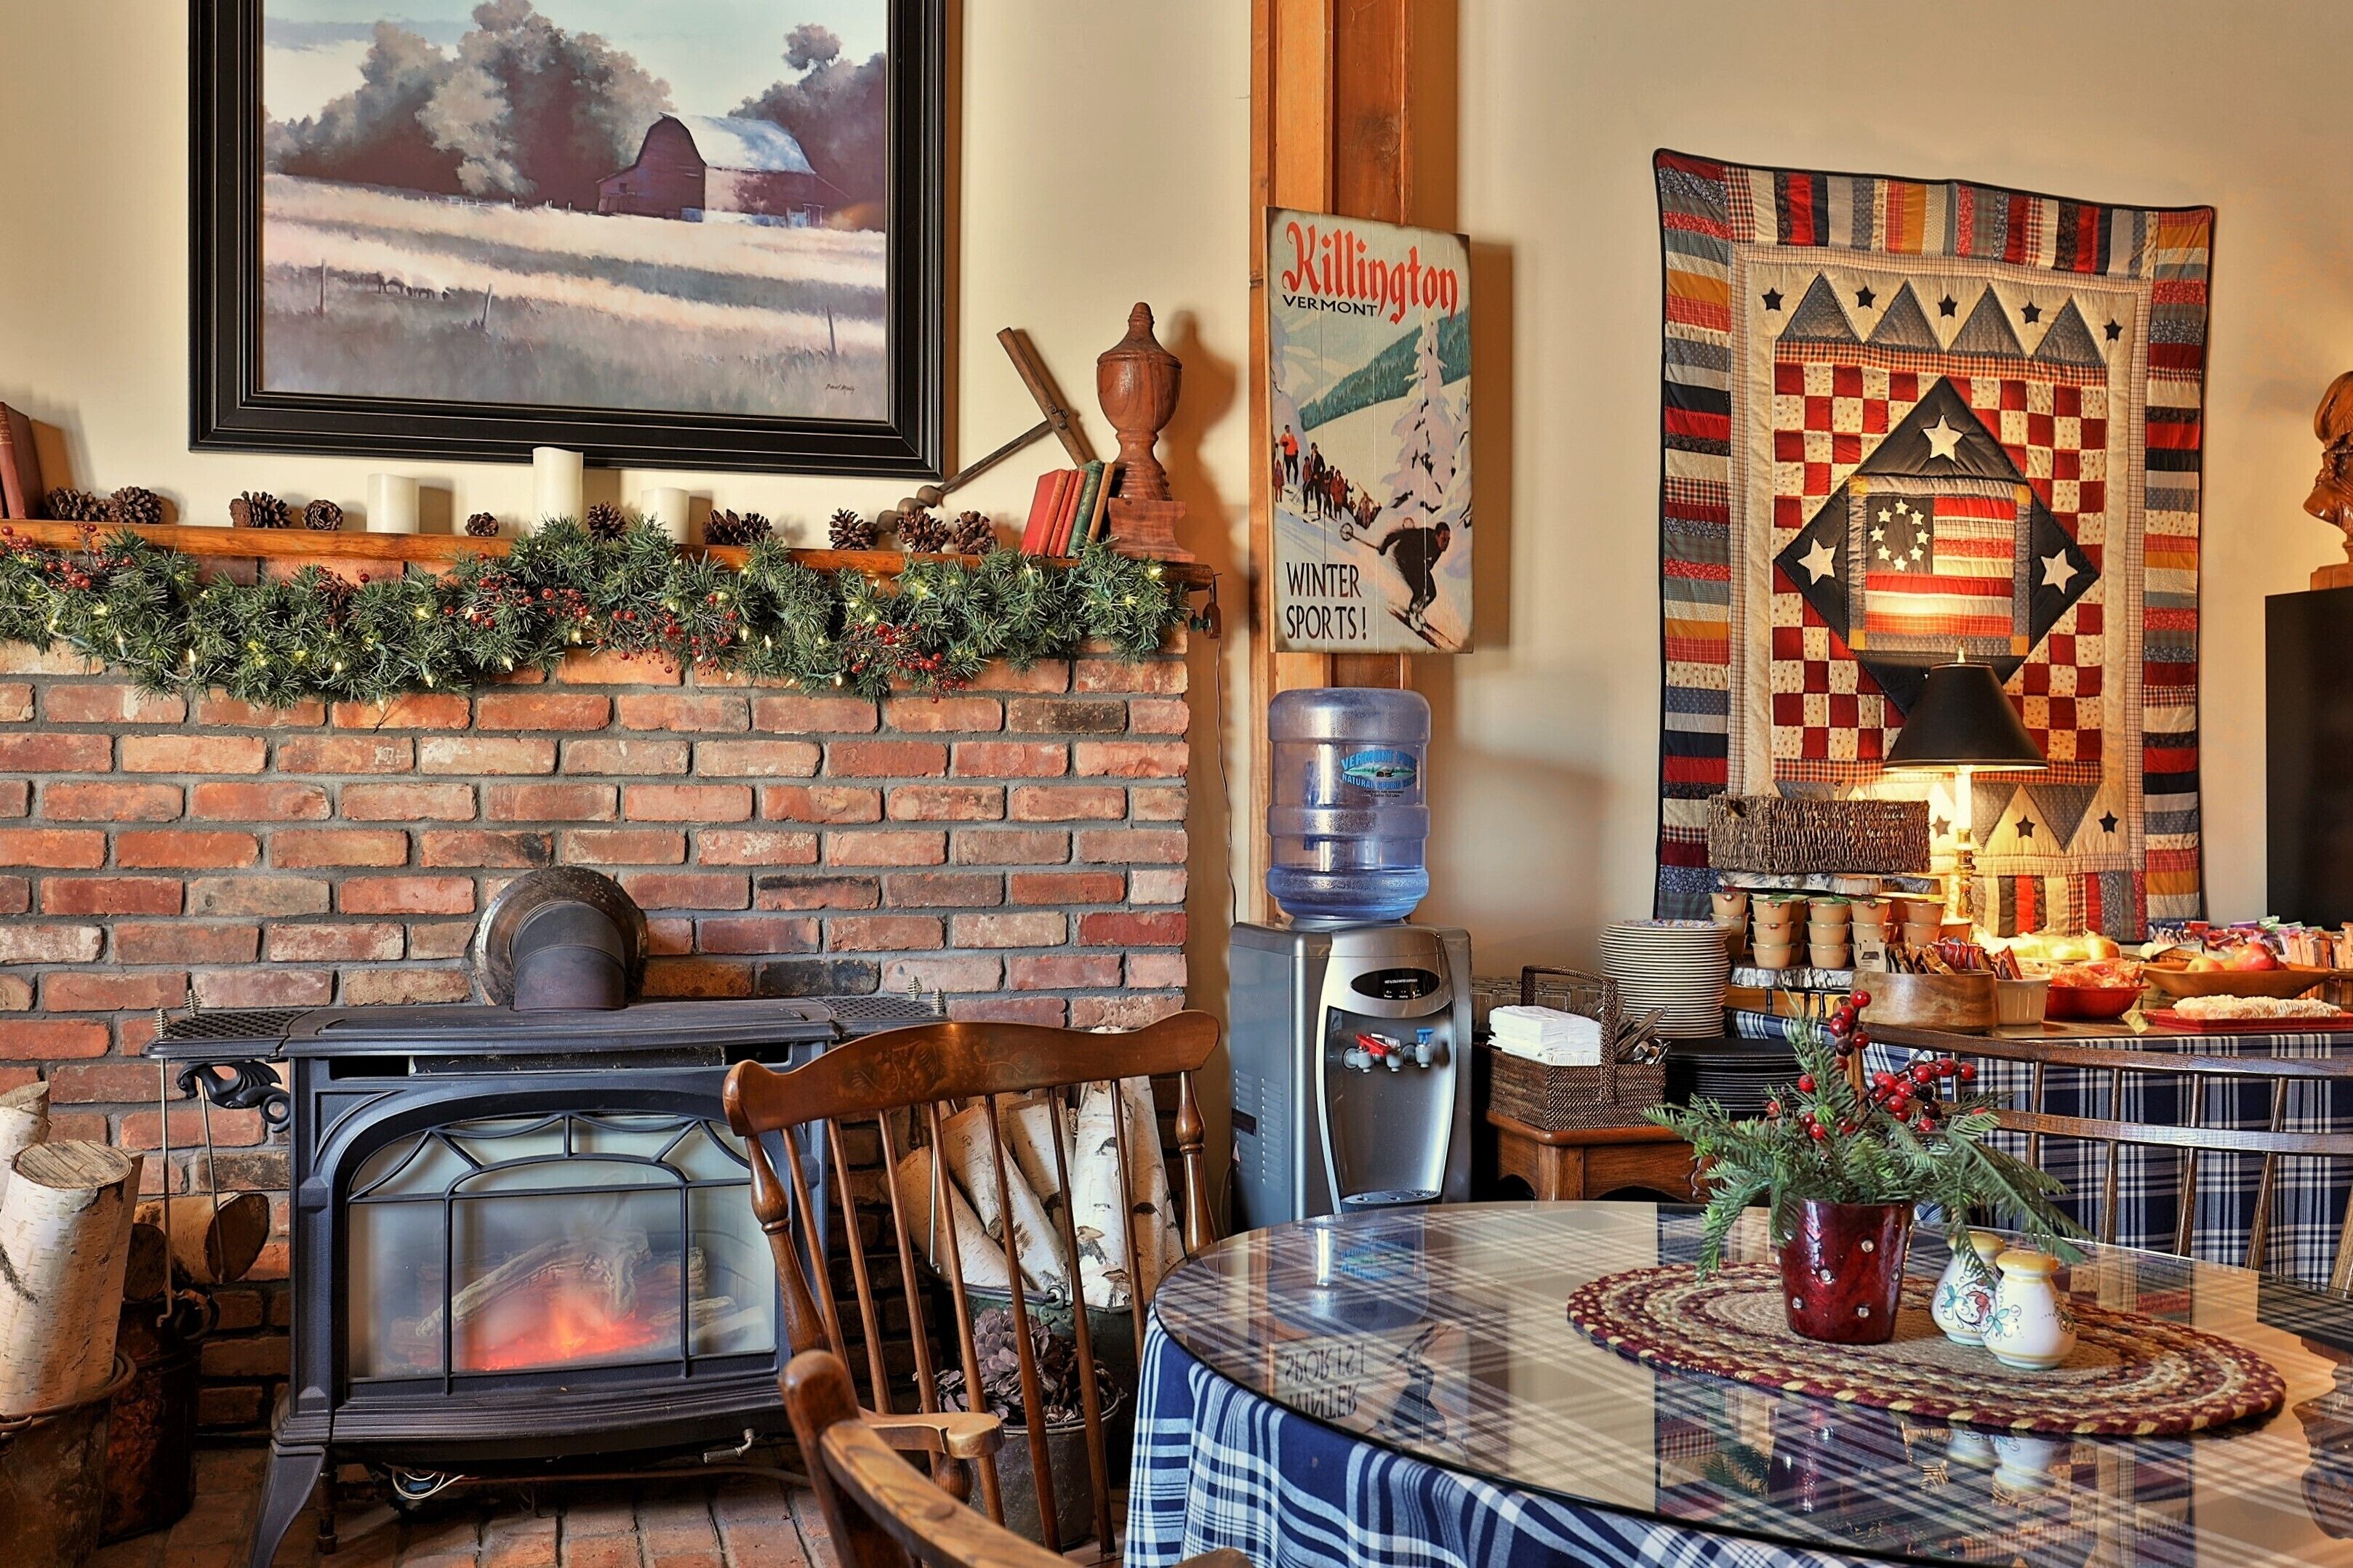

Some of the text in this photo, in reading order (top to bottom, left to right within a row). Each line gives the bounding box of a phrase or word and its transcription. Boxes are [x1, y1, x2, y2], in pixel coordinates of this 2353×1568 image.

[1282, 222, 1458, 325] Killington
[1283, 294, 1378, 316] VERMONT
[1286, 562, 1362, 598] WINTER
[1286, 605, 1367, 640] SPORTS!
[1341, 749, 1394, 771] VERMONT
[1342, 773, 1374, 789] NATURAL
[1376, 780, 1402, 790] SPRING
